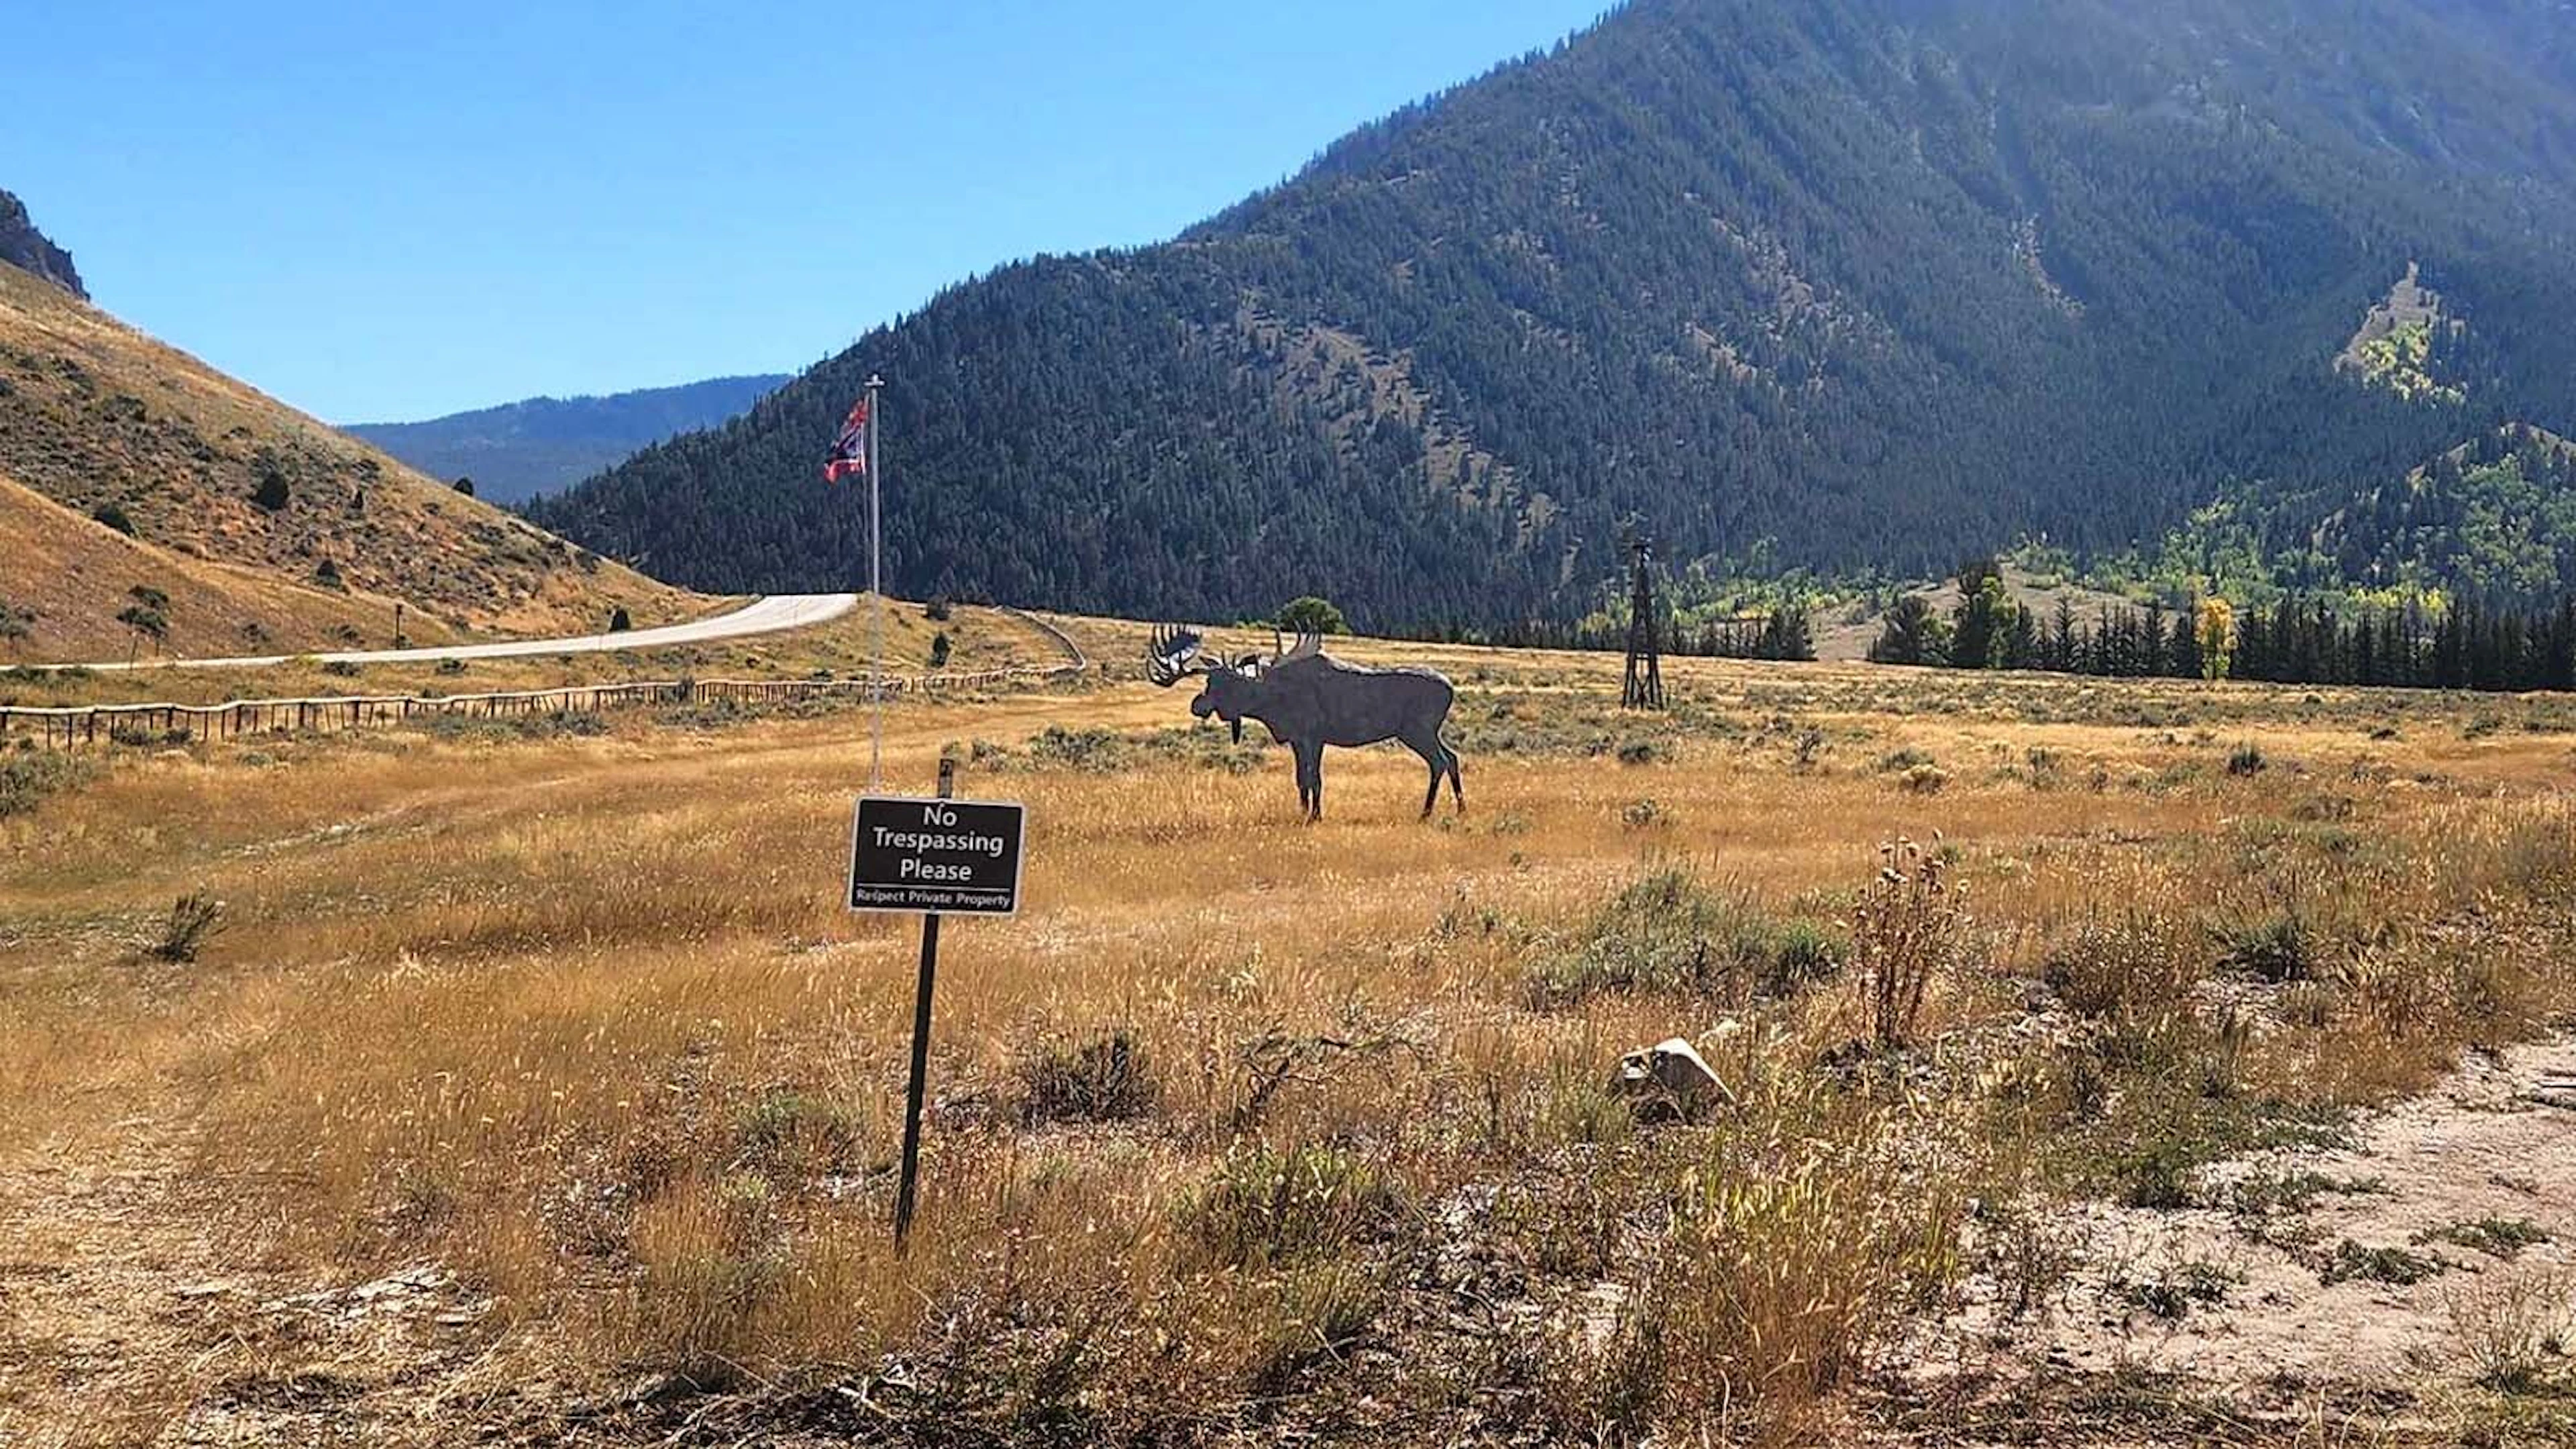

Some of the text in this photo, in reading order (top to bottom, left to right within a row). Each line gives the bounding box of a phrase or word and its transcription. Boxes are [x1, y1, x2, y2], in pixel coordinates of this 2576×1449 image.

[923, 806, 957, 826] No
[873, 826, 1004, 857] Trespassing
[901, 858, 972, 881] Please
[856, 889, 1010, 908] Respect Private Property
